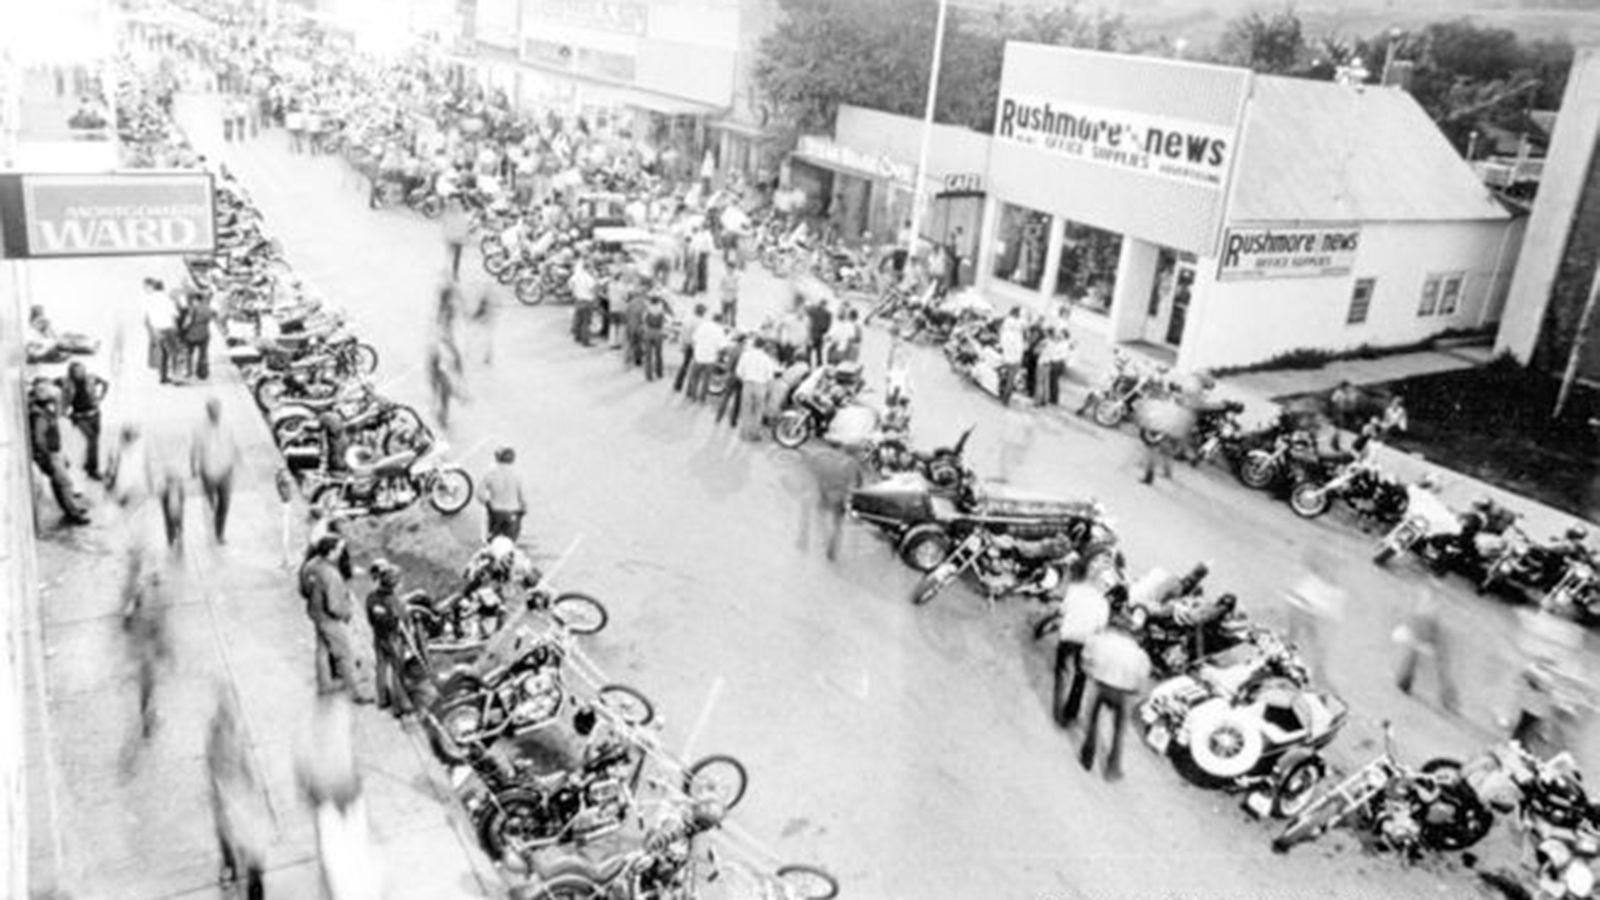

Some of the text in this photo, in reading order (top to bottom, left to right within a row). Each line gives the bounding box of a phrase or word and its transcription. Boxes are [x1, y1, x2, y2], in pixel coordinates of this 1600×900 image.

[1000, 98, 1226, 167] Rushmore news
[38, 217, 197, 249] WARD
[1223, 230, 1359, 267] Rushmore news
